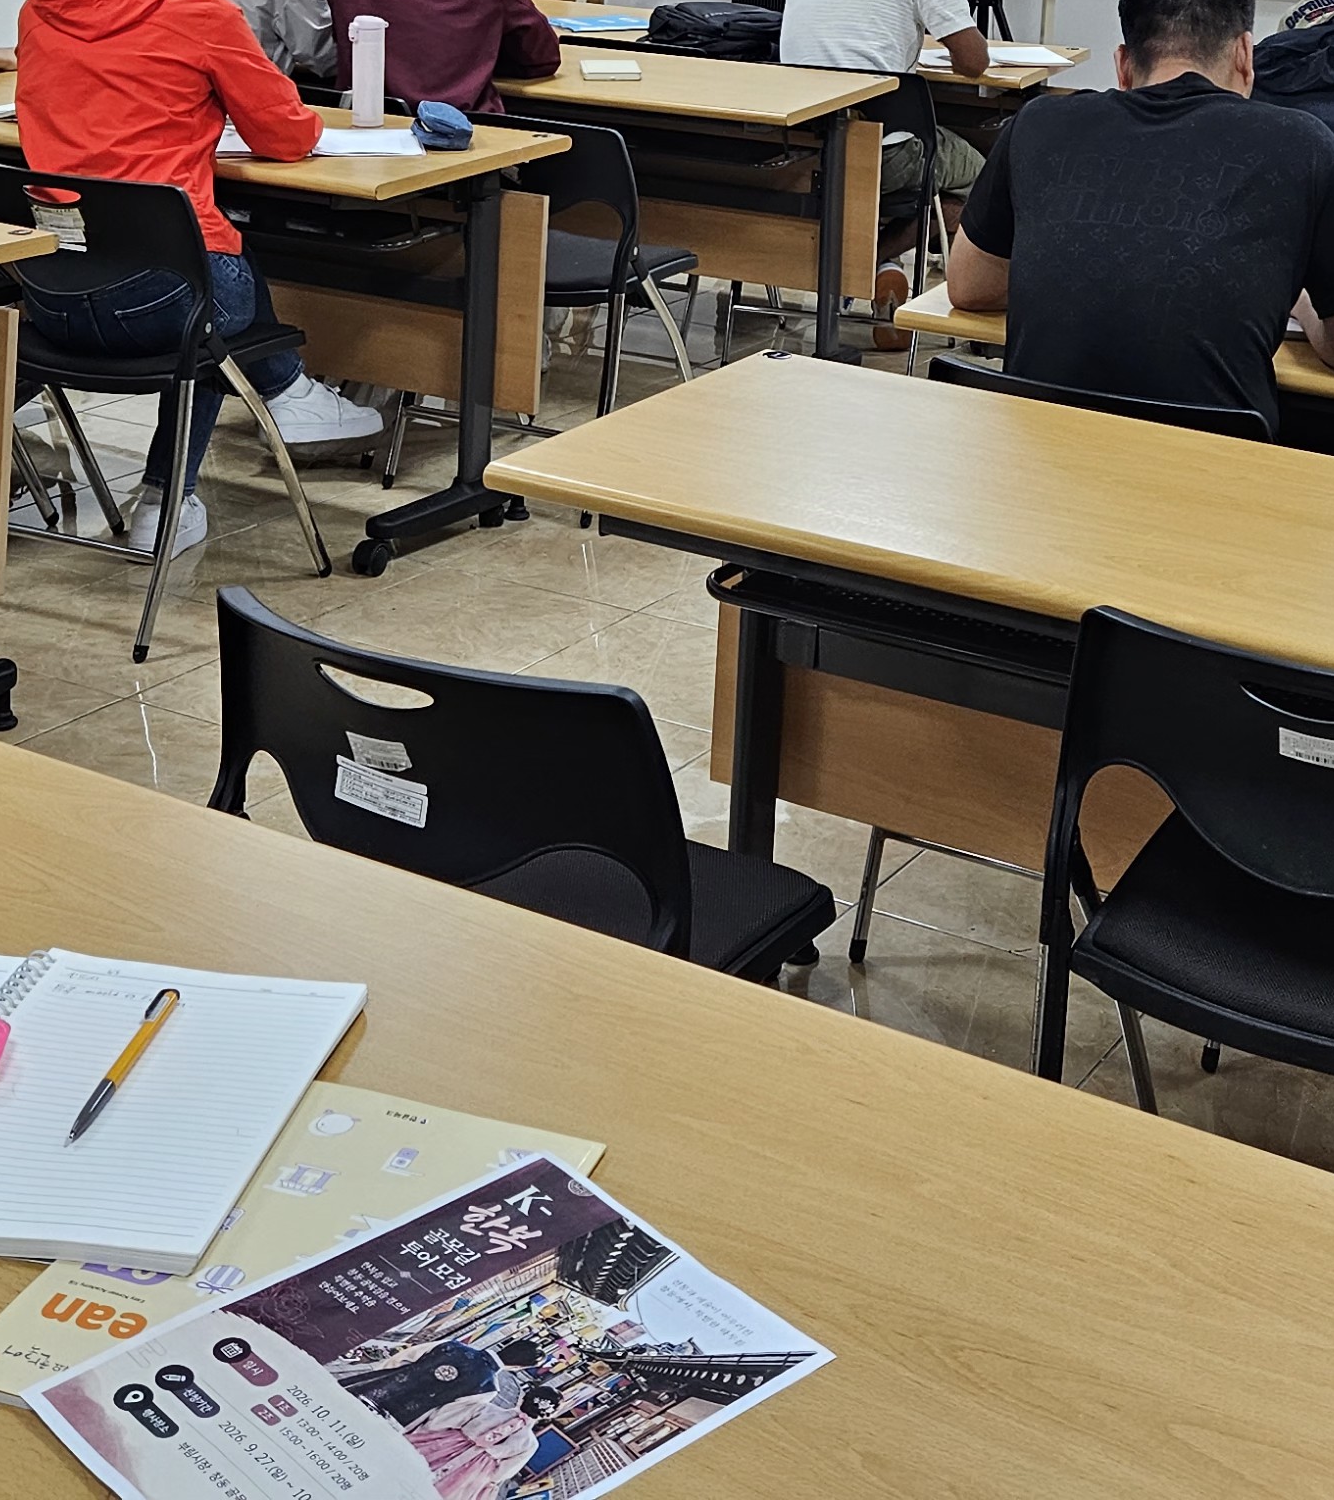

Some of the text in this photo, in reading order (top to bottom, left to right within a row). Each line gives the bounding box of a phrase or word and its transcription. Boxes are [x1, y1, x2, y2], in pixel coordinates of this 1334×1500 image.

[504, 1184, 553, 1217] K-
[423, 1227, 482, 1267] 골목길
[459, 1204, 543, 1255] 한복
[399, 1240, 472, 1291] 투어 모집
[241, 1360, 265, 1378] 일시
[183, 1387, 216, 1415] 신청기간
[286, 1384, 310, 1408] 2026.
[311, 1403, 330, 1421] 10.
[218, 1420, 245, 1447] 2026.
[244, 1442, 259, 1458] 9.
[278, 1426, 304, 1447] 15:00
[305, 1449, 329, 1471] 16:00
[322, 1441, 346, 1462] 14:00
